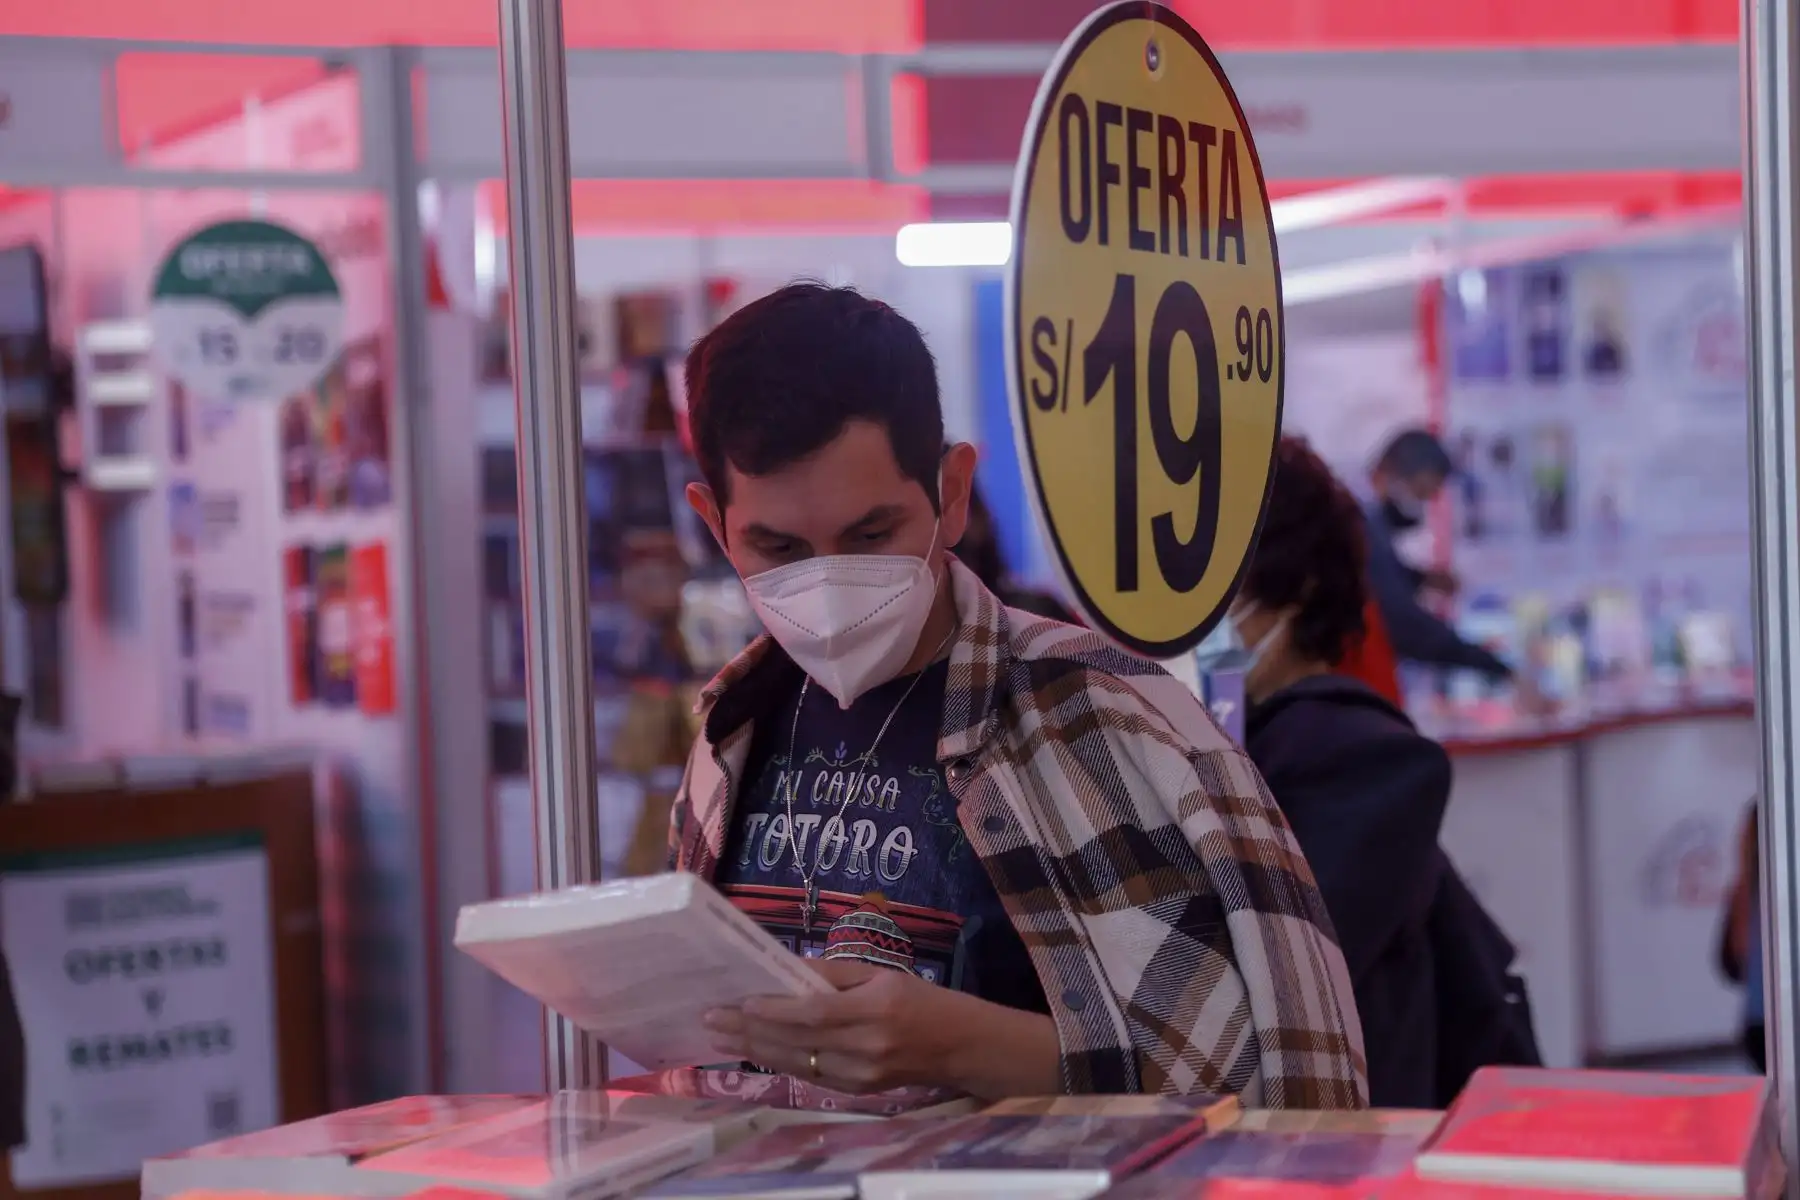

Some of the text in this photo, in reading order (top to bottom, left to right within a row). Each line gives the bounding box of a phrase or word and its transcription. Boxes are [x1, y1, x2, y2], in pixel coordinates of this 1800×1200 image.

[1058, 92, 1246, 266] OFERTA
[772, 769, 901, 811] MI CAUSA
[738, 812, 919, 882] TOTORO
